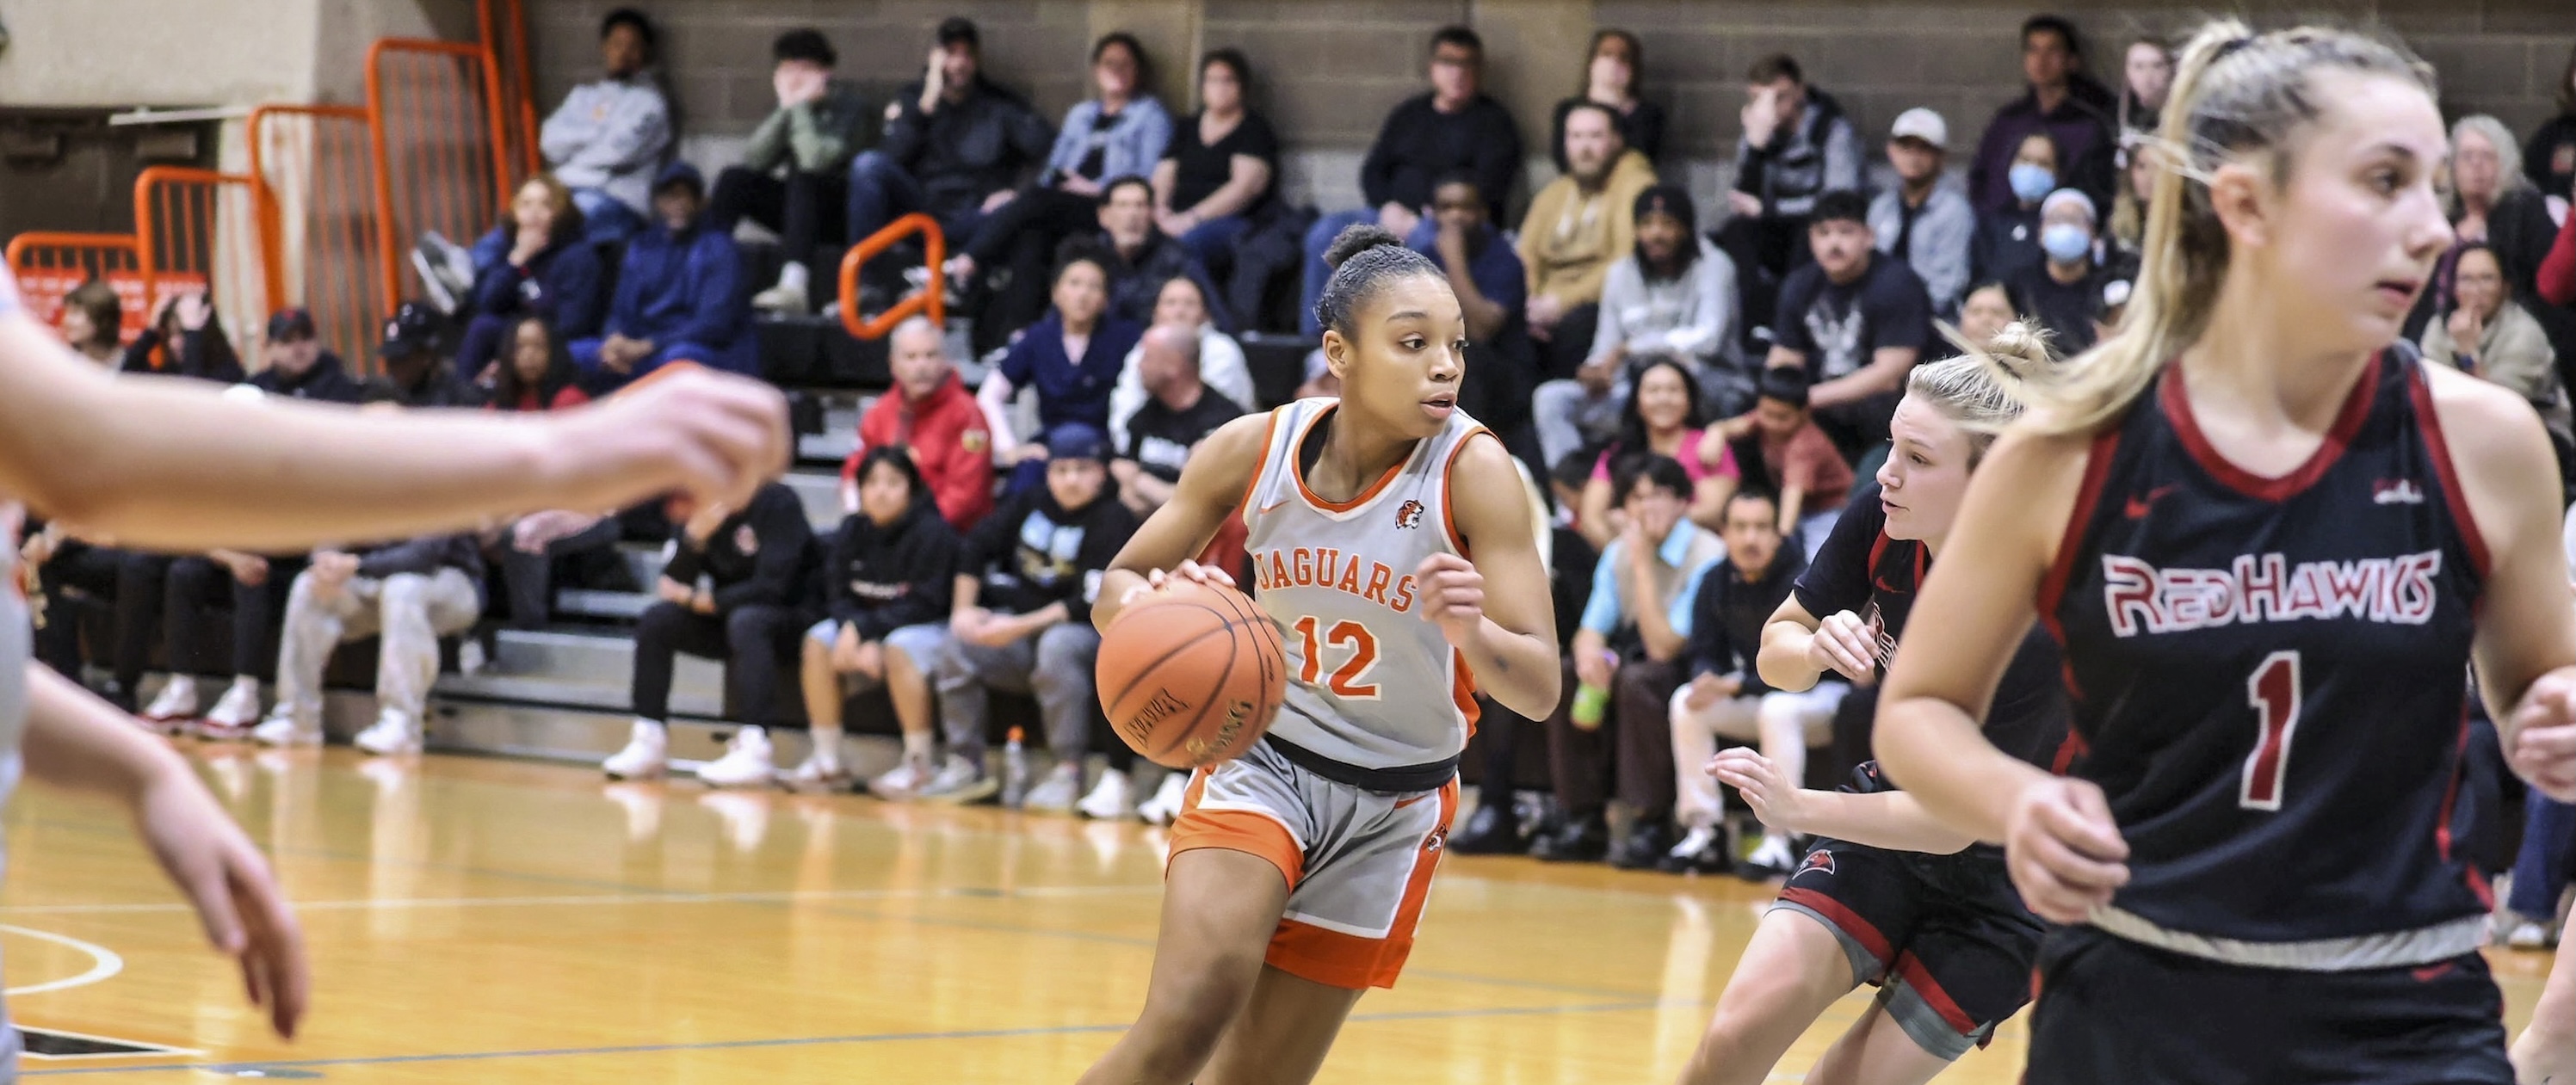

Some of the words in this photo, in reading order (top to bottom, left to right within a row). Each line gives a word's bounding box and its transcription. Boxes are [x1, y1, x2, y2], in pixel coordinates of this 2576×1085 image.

[1254, 546, 1418, 613] JAGUARS
[2102, 549, 2443, 637] REDHAWKS
[1292, 615, 1381, 700] 12
[2239, 650, 2301, 811] 1
